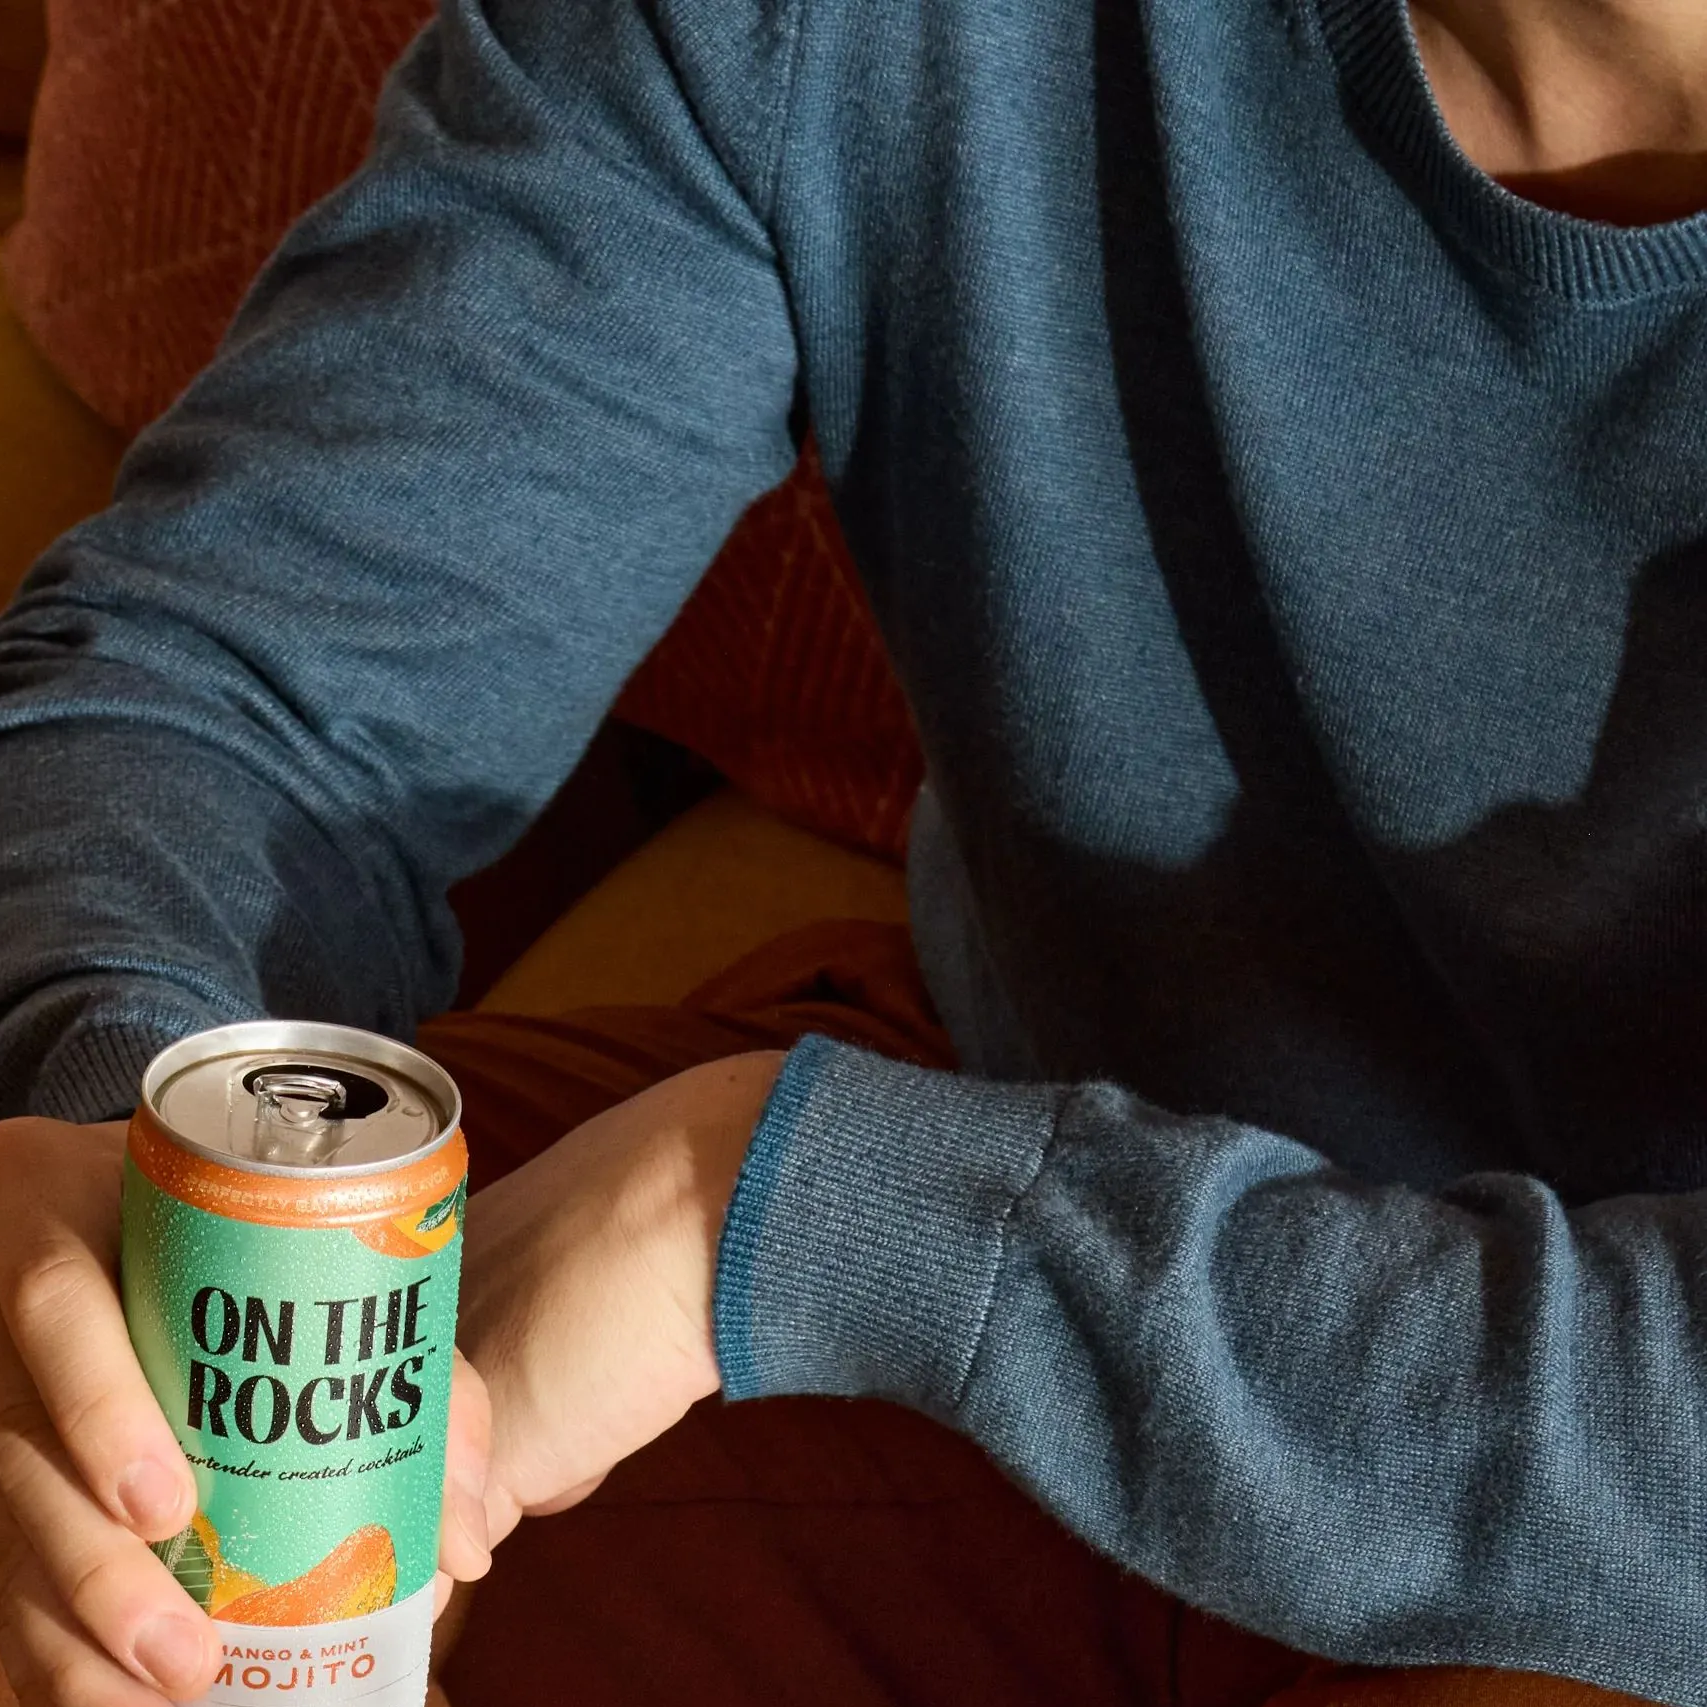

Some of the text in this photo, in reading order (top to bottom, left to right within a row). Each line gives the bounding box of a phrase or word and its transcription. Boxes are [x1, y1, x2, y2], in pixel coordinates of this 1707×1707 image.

[192, 1276, 432, 1366] ON THE
[278, 1459, 355, 1481] created
[357, 1435, 427, 1474] cocktails
[299, 1648, 313, 1661] &
[320, 1636, 369, 1659] MINT
